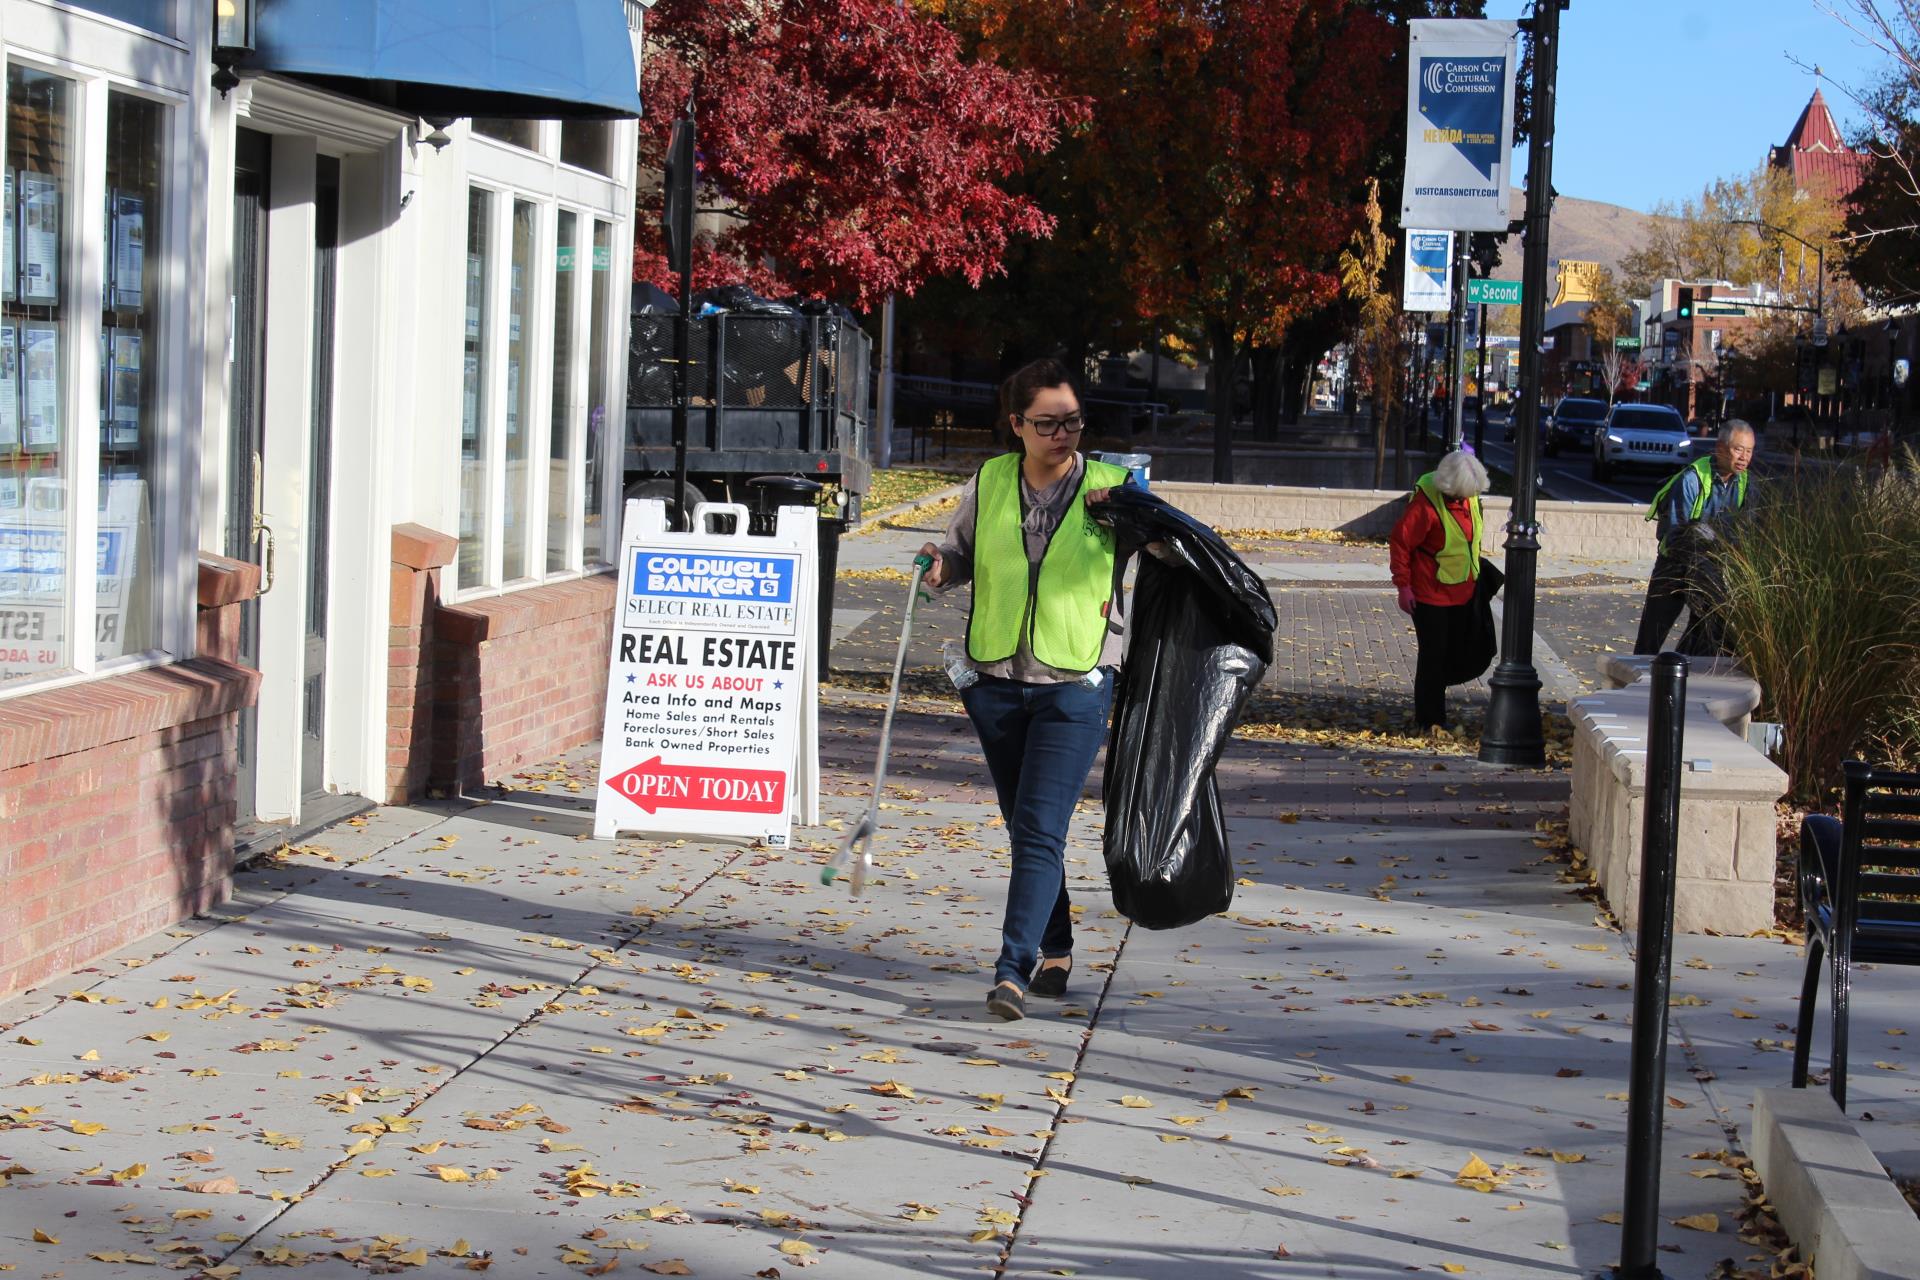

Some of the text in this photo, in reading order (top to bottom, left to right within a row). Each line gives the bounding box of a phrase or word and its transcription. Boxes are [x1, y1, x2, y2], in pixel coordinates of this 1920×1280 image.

[1445, 61, 1501, 72] CARSON CITY
[1447, 73, 1489, 82] CULTURAL
[1445, 83, 1496, 93] COMMISSION
[1424, 127, 1463, 144] NEVADA
[1415, 187, 1499, 198] VISITCARSONCITY.COM
[1482, 283, 1518, 300] Second
[647, 556, 781, 580] COLDWELL
[647, 574, 754, 598] BANKER
[628, 599, 793, 622] SELECT REAL ESTATE
[619, 633, 796, 671] REAL ESTATE
[646, 673, 764, 692] ASK US ABOUT
[623, 691, 782, 714] Area Info and Maps
[626, 709, 775, 726] Home Sales and Rentals
[744, 729, 775, 741] Sales
[625, 737, 770, 755] Bank Owned Properties
[622, 773, 779, 803] OPEN TODAY
